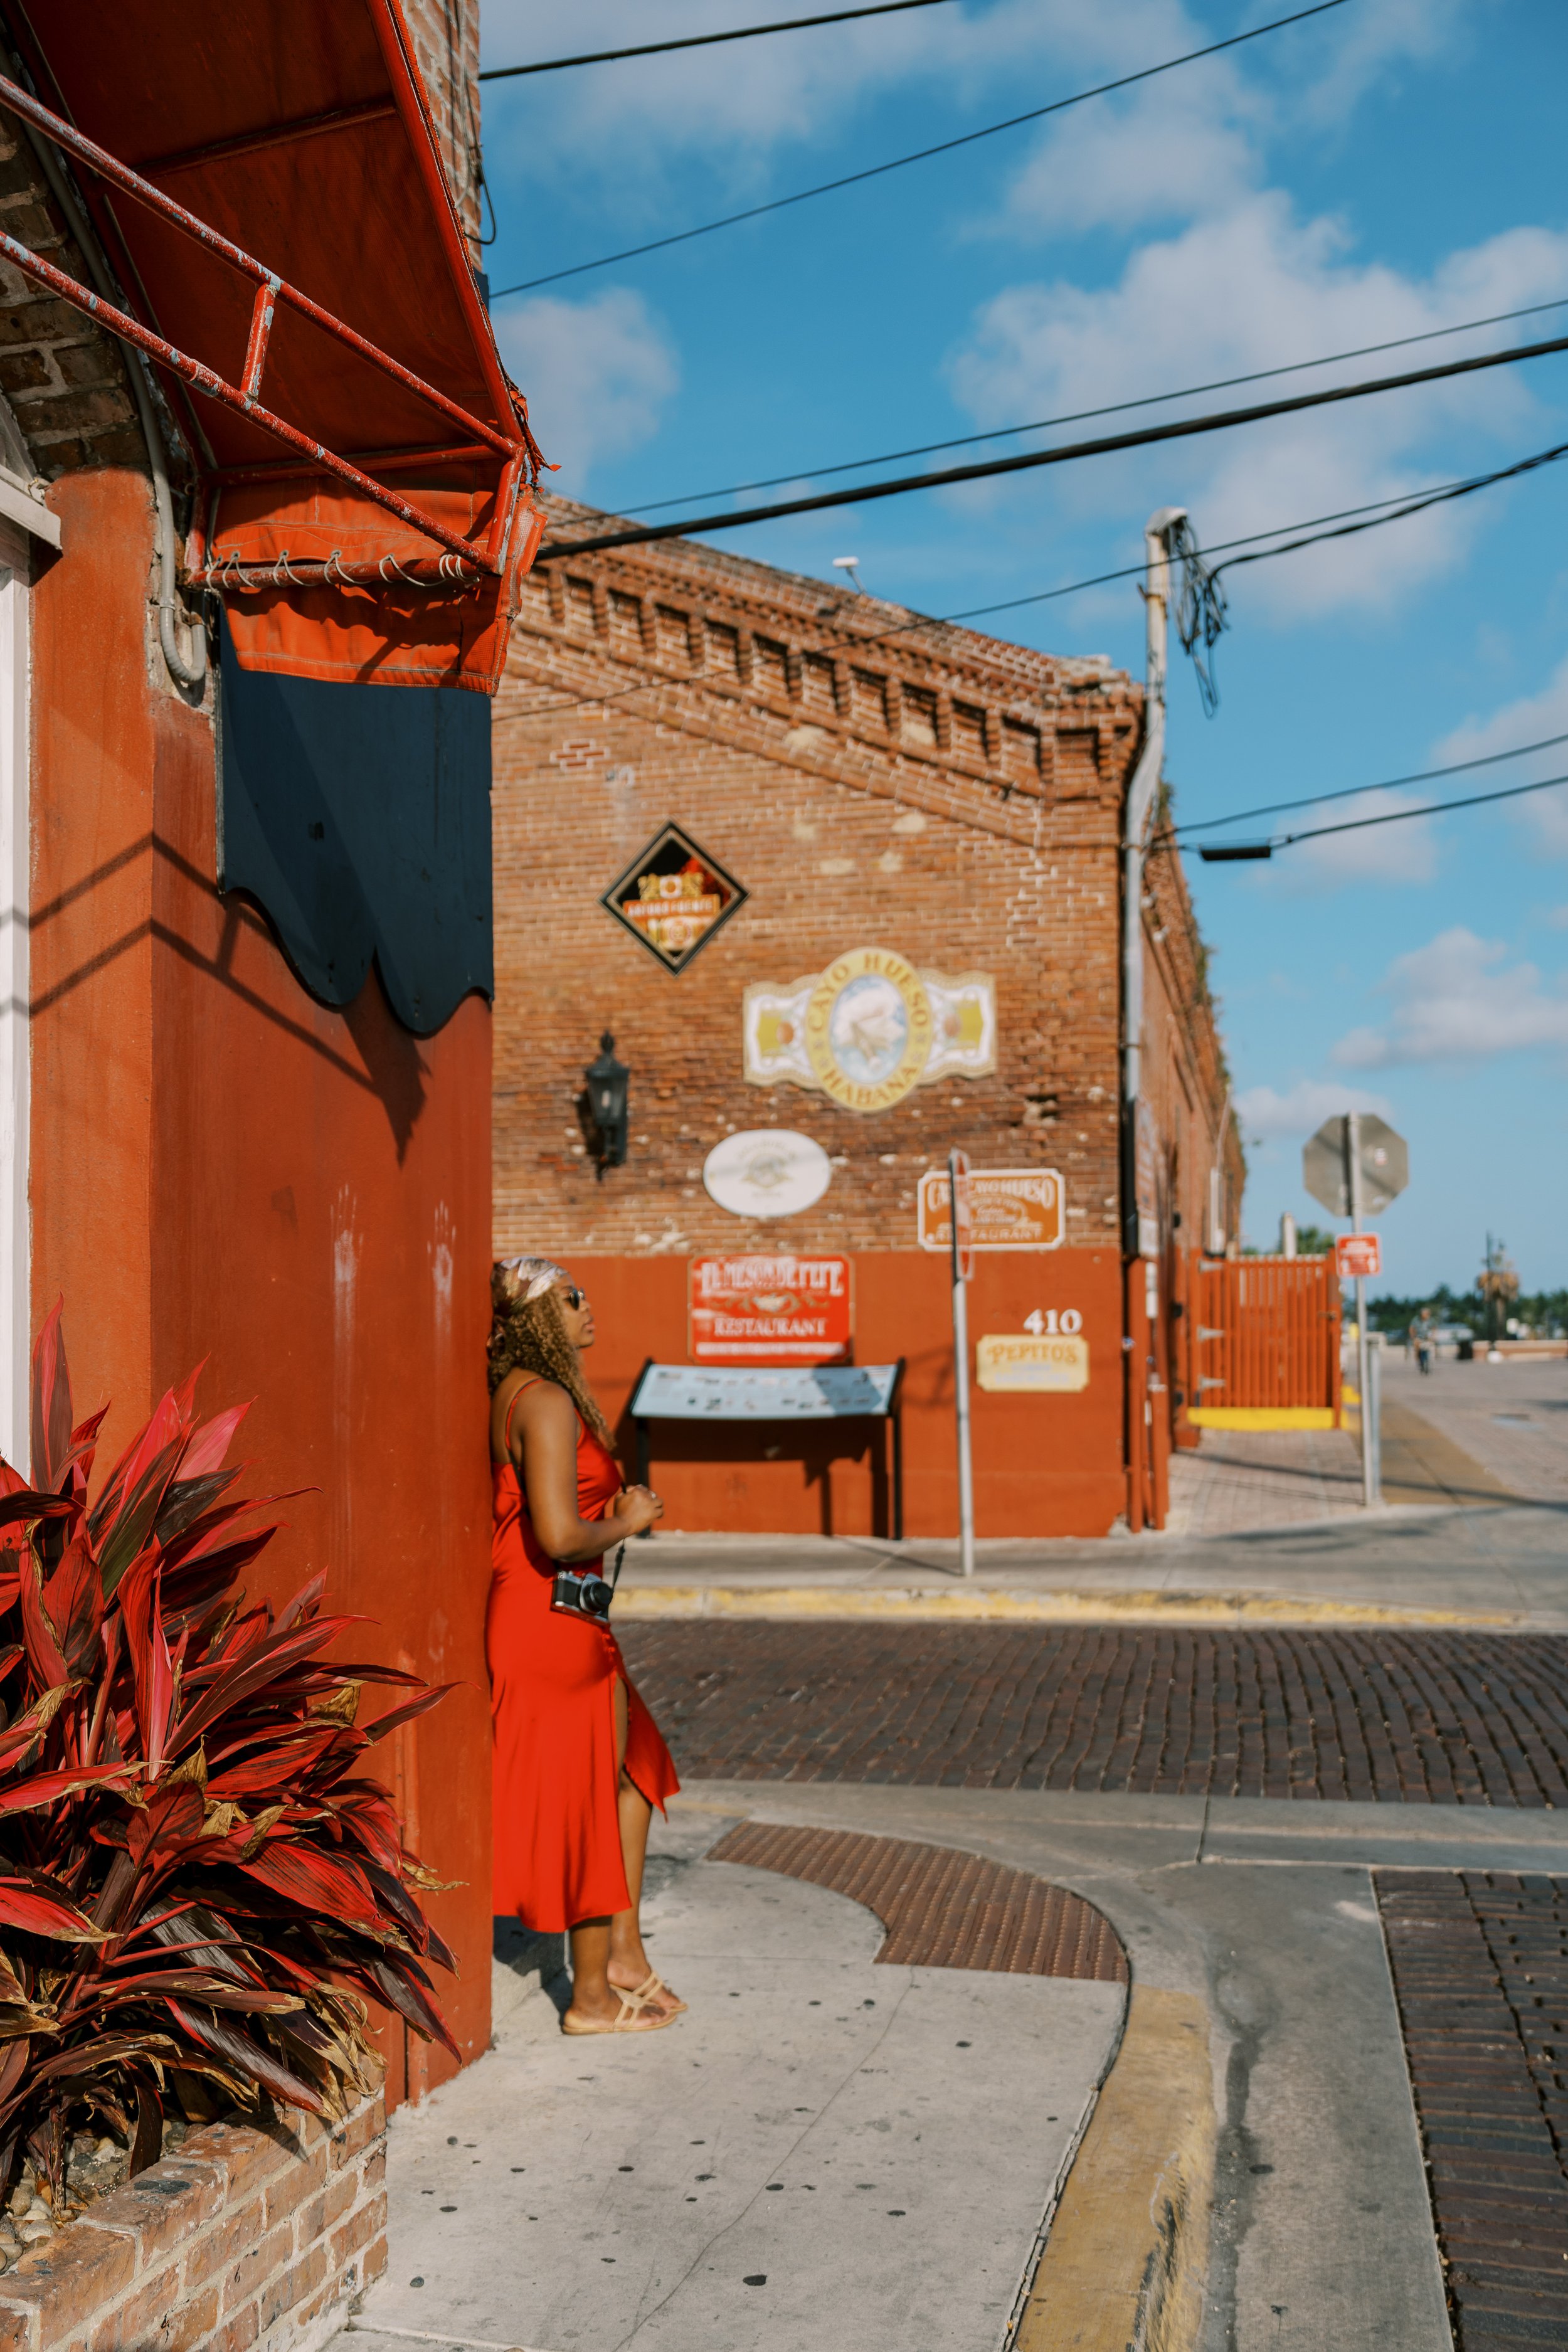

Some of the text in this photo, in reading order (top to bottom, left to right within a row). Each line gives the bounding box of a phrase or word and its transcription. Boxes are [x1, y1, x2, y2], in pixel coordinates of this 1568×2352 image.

[809, 952, 929, 1032] CAYO HUESO
[822, 1065, 918, 1106] HABANA
[1000, 1177, 1056, 1210] HUESO
[713, 1316, 828, 1337] RESTAURANT
[1023, 1308, 1084, 1336] 410
